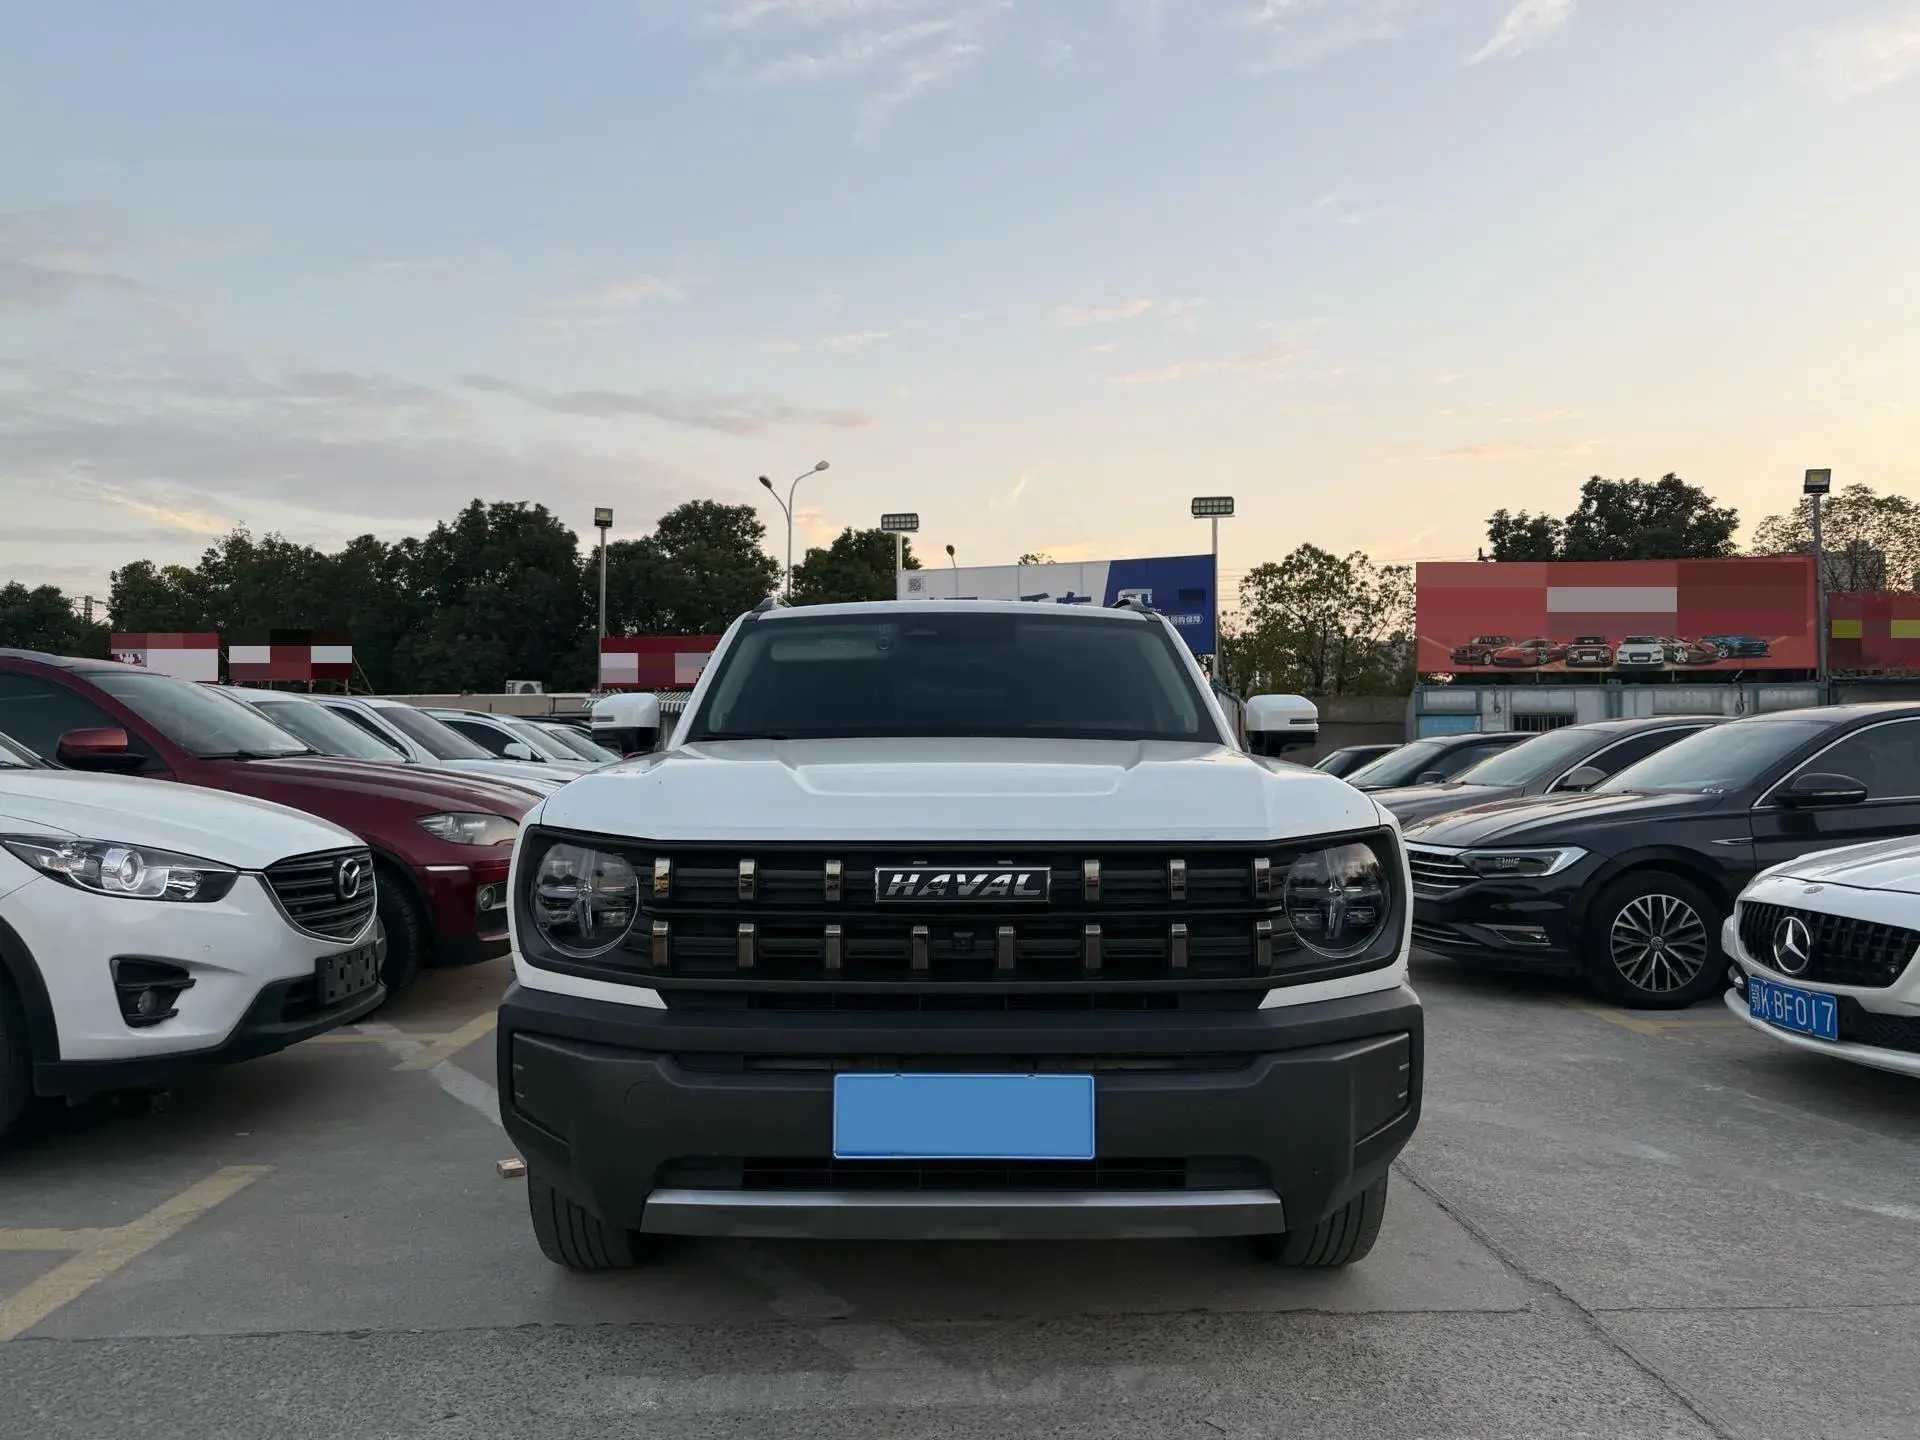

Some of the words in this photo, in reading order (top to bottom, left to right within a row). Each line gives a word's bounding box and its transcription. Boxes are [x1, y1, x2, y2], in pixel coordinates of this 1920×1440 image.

[1166, 615, 1201, 624] 回购保障
[886, 874, 1041, 896] HAVAL
